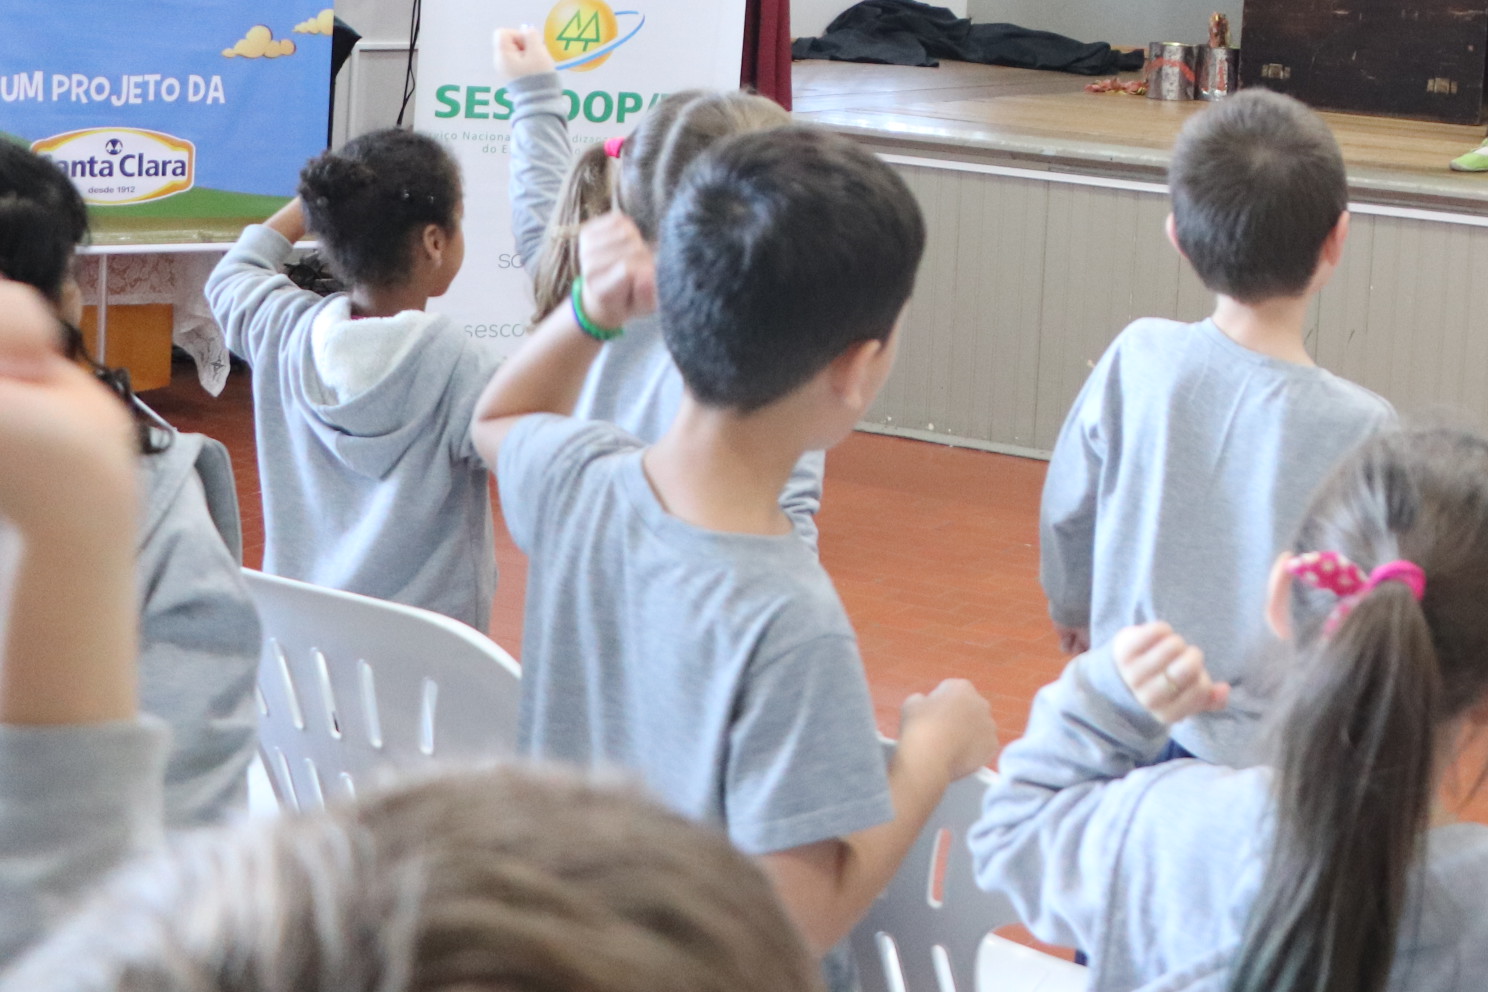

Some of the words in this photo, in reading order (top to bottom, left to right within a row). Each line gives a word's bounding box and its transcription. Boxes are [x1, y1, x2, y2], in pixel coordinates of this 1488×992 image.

[1, 70, 44, 102] UM
[52, 73, 181, 107] PROJETO
[187, 74, 227, 105] DA
[462, 130, 511, 142] Naciona
[56, 155, 114, 178] anta
[119, 152, 187, 178] Clara
[88, 186, 115, 194] desde
[117, 185, 136, 194] 1912
